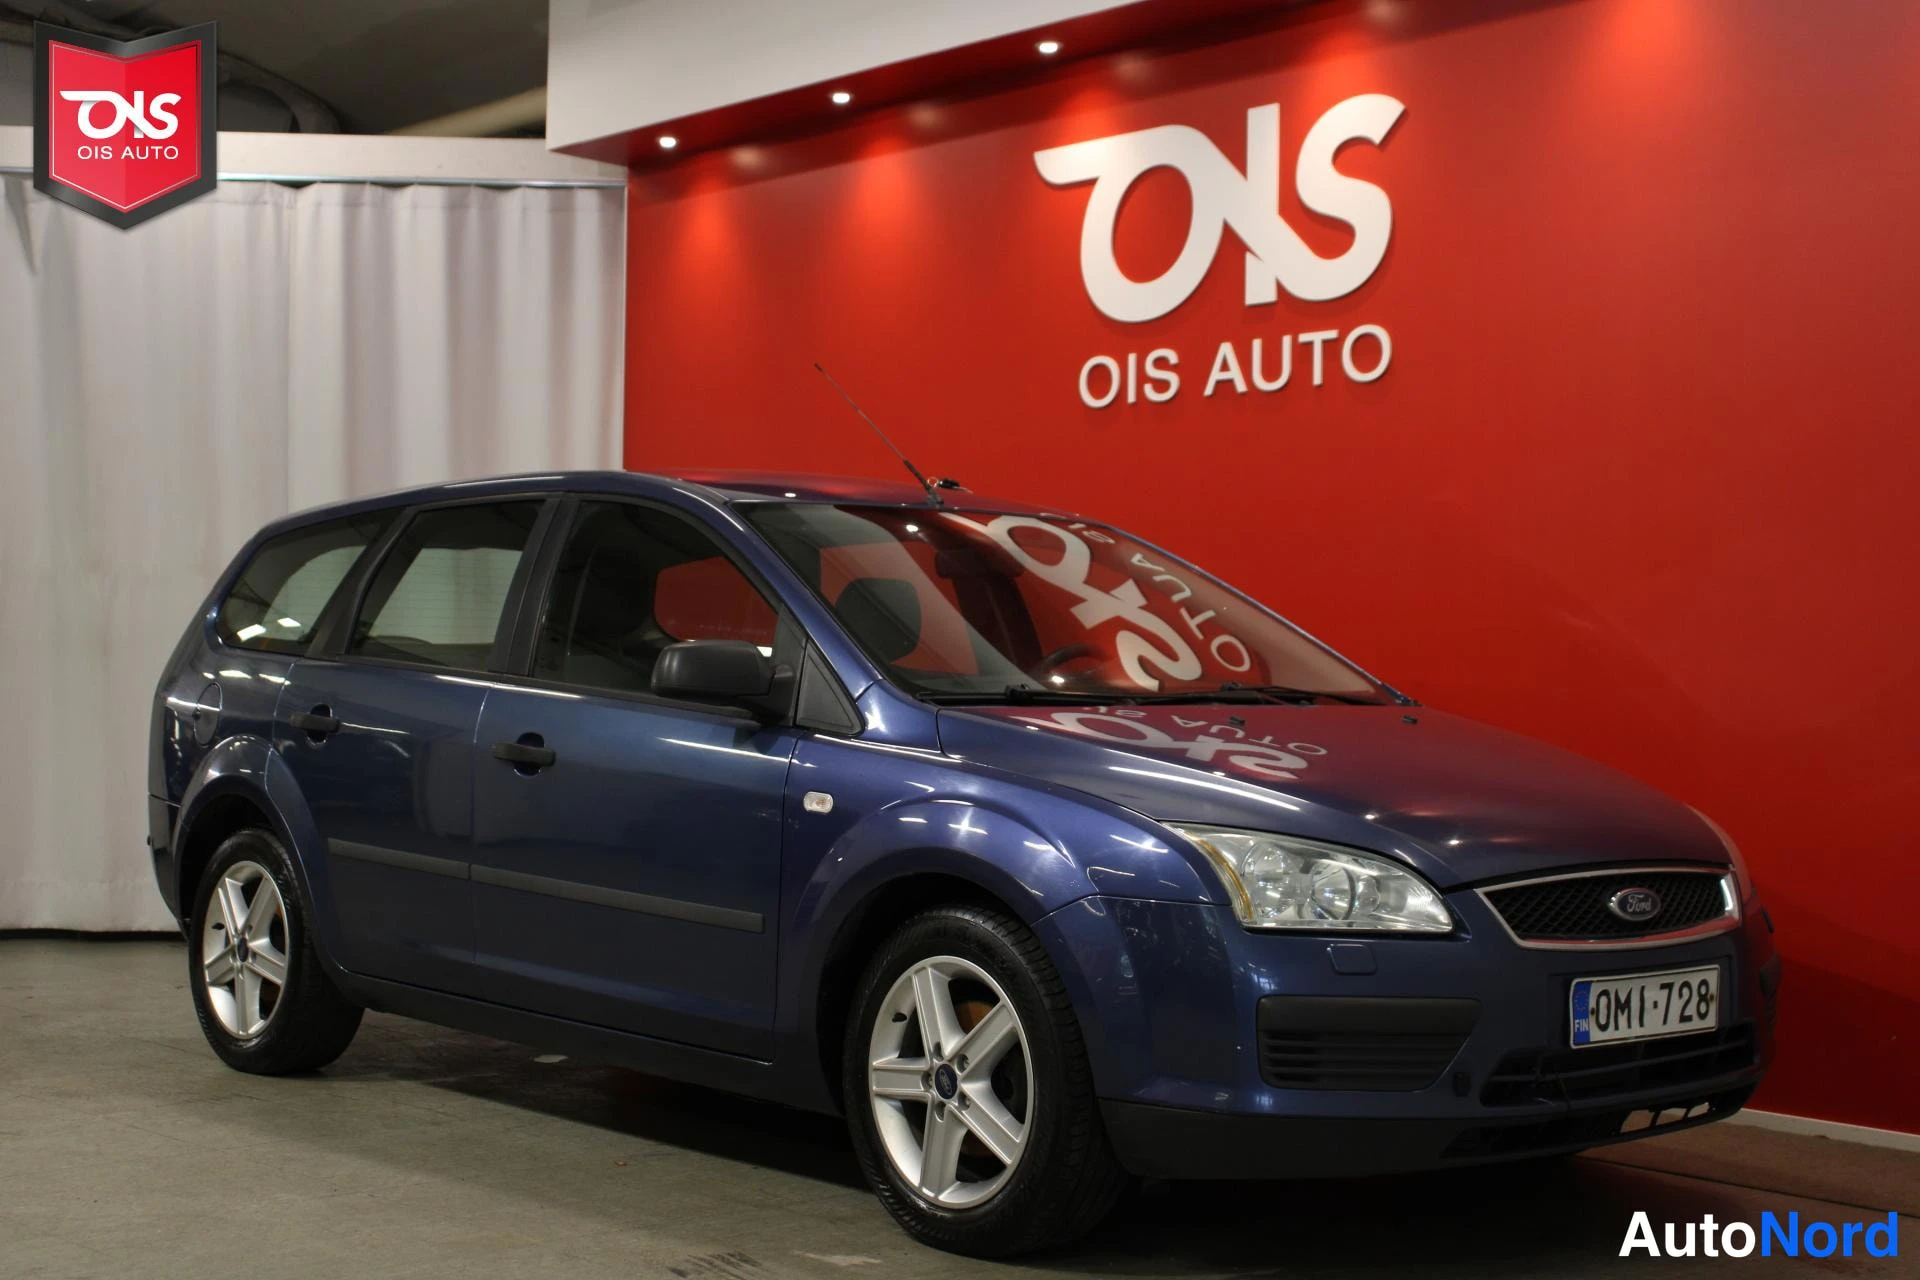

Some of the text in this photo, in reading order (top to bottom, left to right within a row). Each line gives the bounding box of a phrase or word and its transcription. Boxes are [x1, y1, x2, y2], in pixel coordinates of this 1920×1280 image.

[1034, 94, 1405, 322] OIS
[1079, 324, 1392, 408] OIS AUTO
[1627, 894, 1652, 912] Ford
[1575, 979, 1710, 1032] FIN OMI-728
